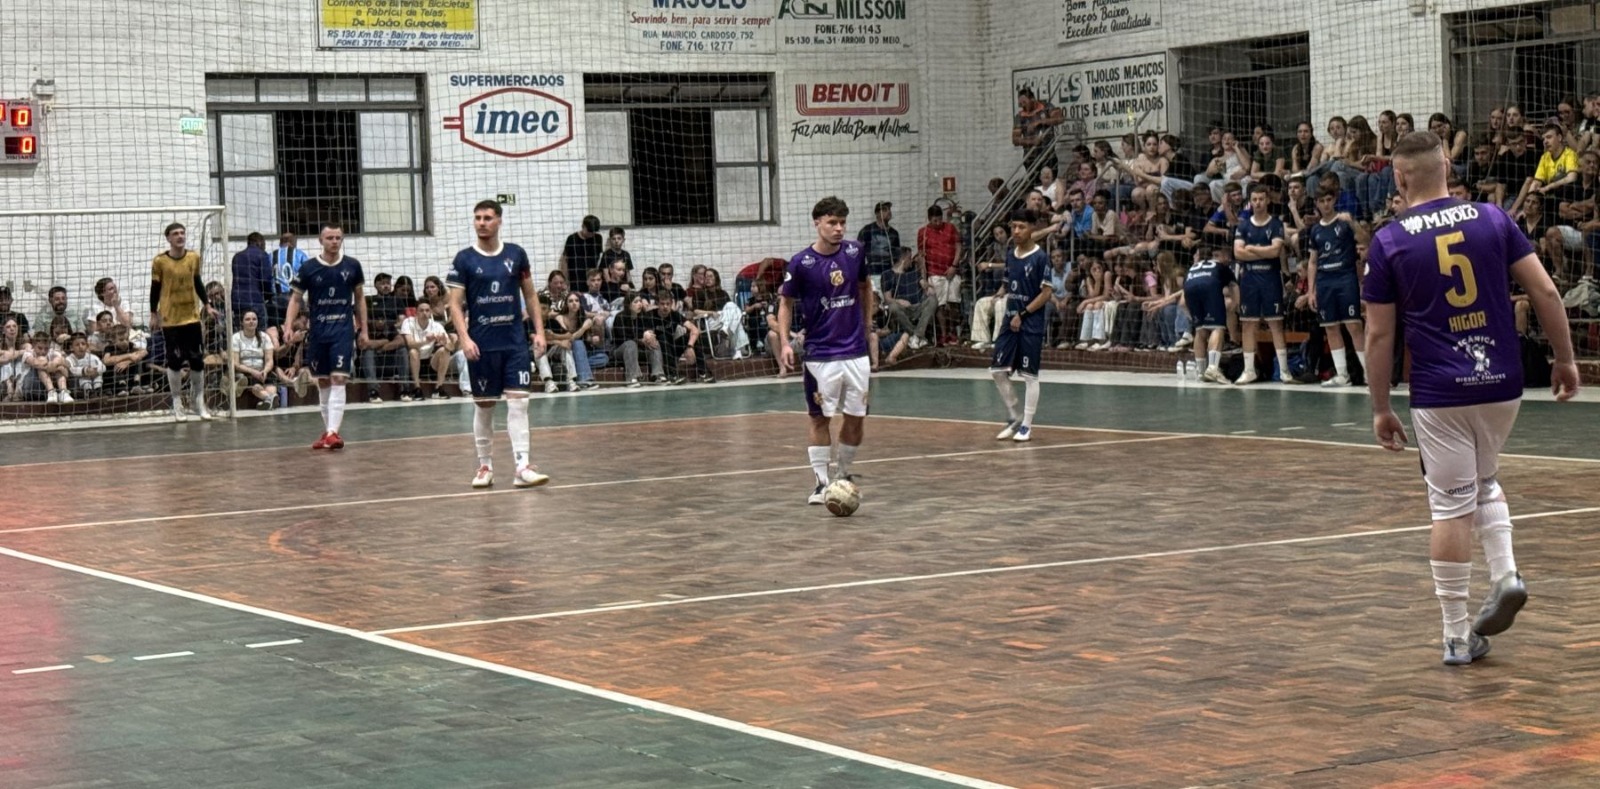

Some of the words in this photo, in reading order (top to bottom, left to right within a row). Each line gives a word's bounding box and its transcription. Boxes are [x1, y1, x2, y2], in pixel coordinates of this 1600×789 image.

[836, 0, 906, 19] NILSSON
[1065, 0, 1087, 12] Bom
[352, 18, 365, 26] De
[405, 19, 448, 28] Guedes
[693, 15, 711, 28] para
[714, 15, 738, 25] servir
[1066, 12, 1097, 26] Preços
[1100, 6, 1129, 21] Baixos
[859, 24, 881, 34] 1143
[1066, 22, 1107, 39] Excelente
[1110, 12, 1151, 32] Qualidade
[327, 30, 339, 38] RS
[342, 30, 356, 38] 130
[358, 30, 371, 38] Km
[373, 30, 384, 38] 82
[391, 31, 416, 40] Bairro
[662, 31, 697, 39] MAURICIO
[741, 31, 754, 39] 752
[814, 36, 825, 45] Km
[826, 36, 836, 44] 31
[841, 36, 865, 44] ARROIO
[869, 36, 878, 44] DO
[711, 41, 733, 51] 1277
[450, 74, 565, 87] SUPERMERCADOS
[1085, 67, 1120, 84] TIJOLOS
[812, 83, 895, 102] BENOIT
[1091, 79, 1158, 100] MOSQUITEIROS
[1093, 103, 1098, 117] E
[1100, 95, 1164, 116] ALAMBRADOS
[18, 109, 29, 126] 0
[474, 103, 559, 135] imec
[791, 119, 809, 142] Faz
[832, 117, 854, 135] Vida
[853, 119, 876, 141] Bem
[22, 137, 33, 154] 0
[1422, 205, 1478, 229] MAJOLO
[1435, 230, 1478, 308] 5
[1274, 303, 1280, 313] 7
[1348, 305, 1355, 316] 6
[1448, 310, 1488, 333] HIGOR
[336, 355, 344, 368] 3
[1022, 356, 1029, 368] 9
[518, 371, 531, 385] 10
